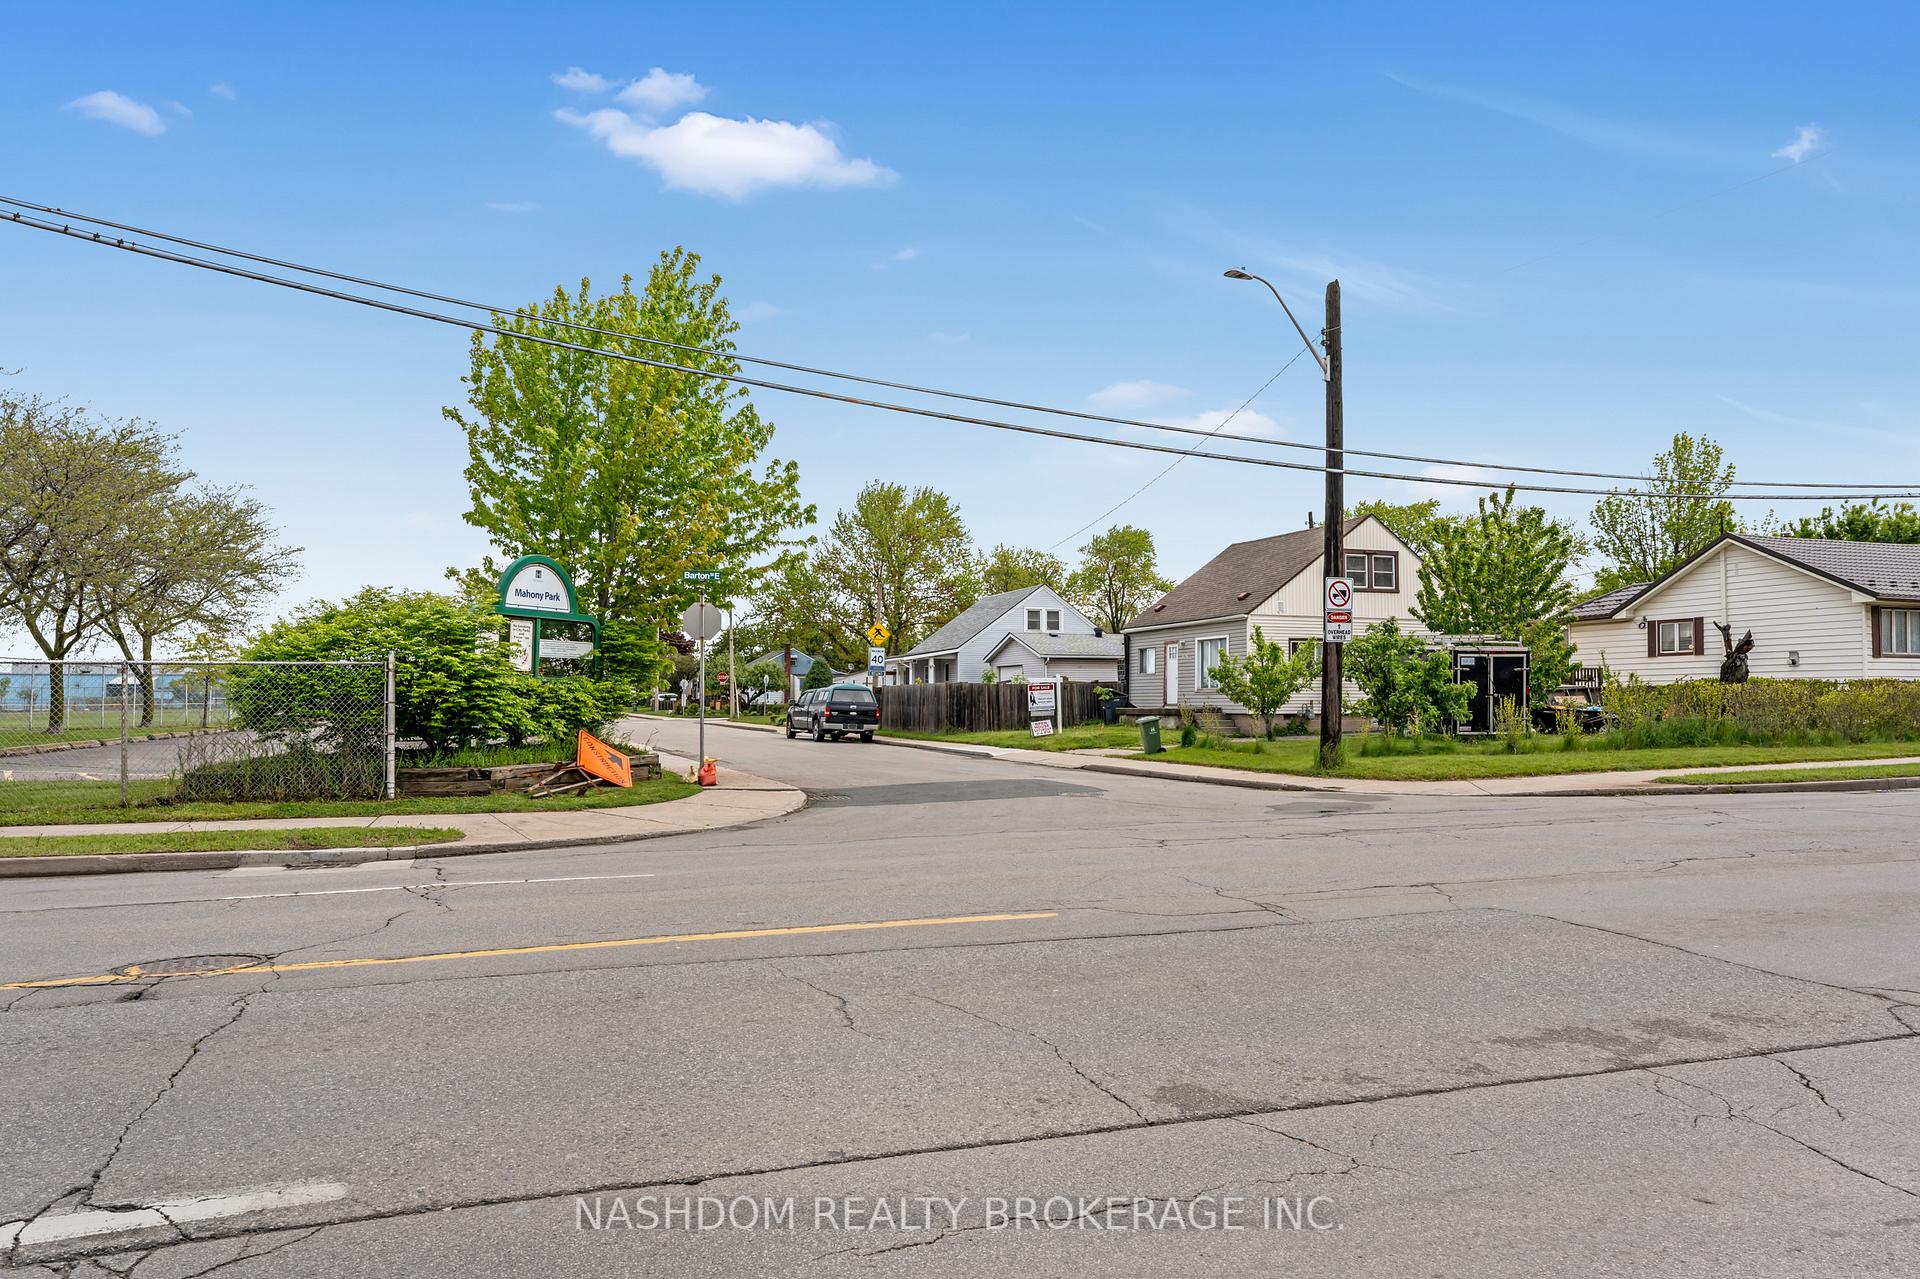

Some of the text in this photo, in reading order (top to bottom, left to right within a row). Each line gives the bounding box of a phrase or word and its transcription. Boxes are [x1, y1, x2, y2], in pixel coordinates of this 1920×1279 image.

[684, 571, 710, 580] Barton
[714, 572, 721, 580] E
[514, 588, 560, 602] Mahony Park
[871, 655, 884, 664] 40
[583, 736, 625, 784] CONSTRUCTION
